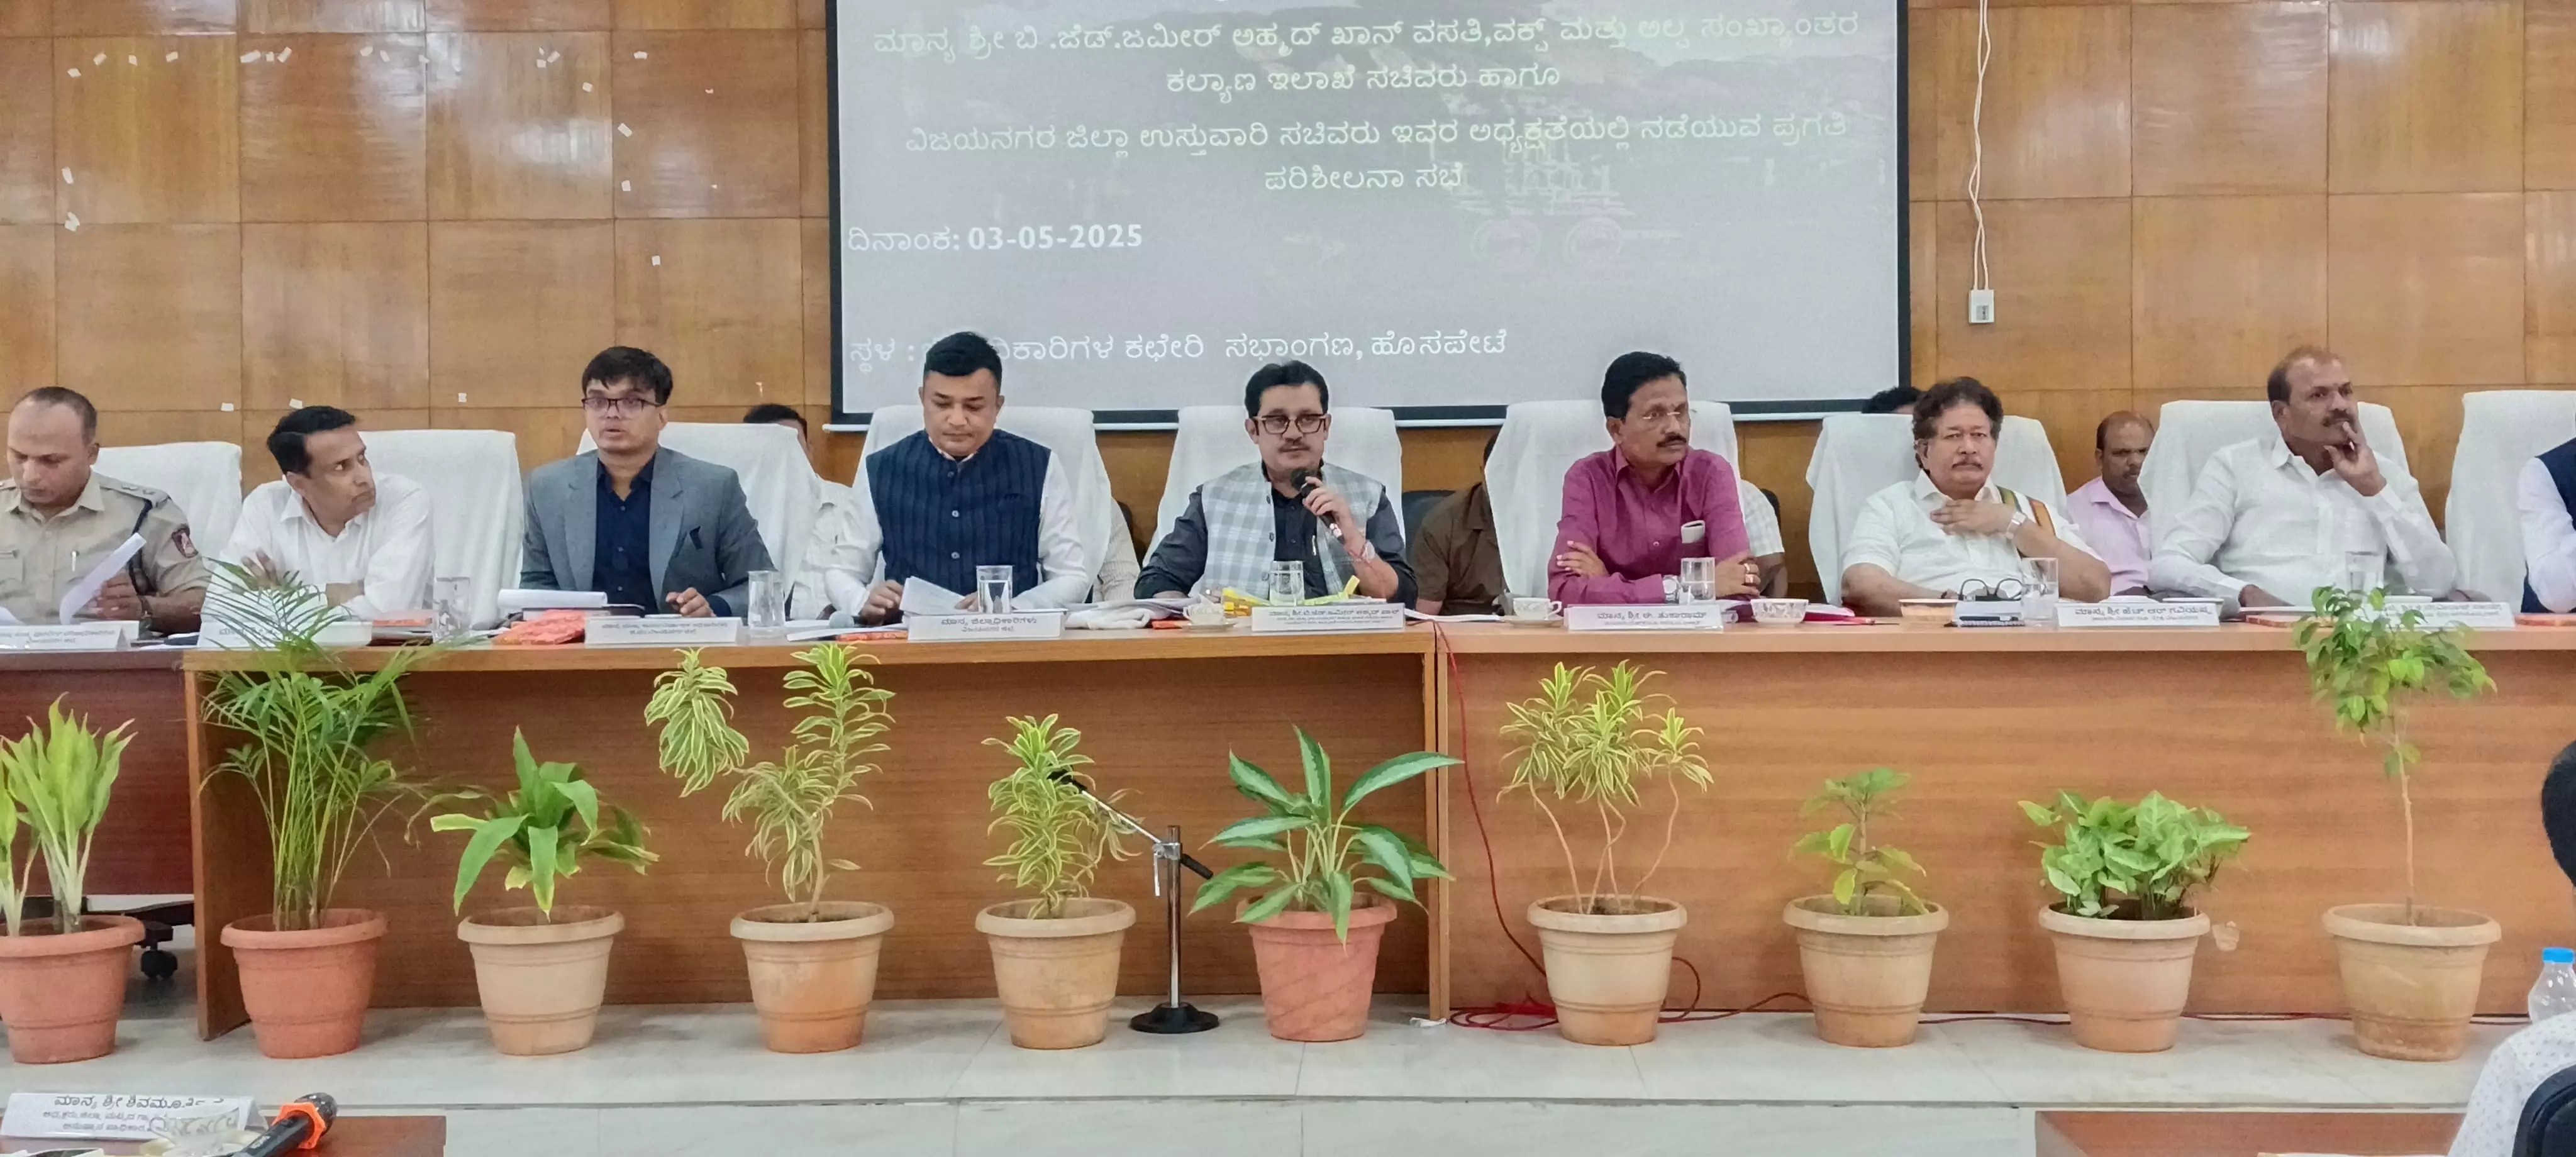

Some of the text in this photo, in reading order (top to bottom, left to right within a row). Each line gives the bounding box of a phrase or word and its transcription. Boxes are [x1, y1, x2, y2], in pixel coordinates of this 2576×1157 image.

[874, 28, 956, 64] ಮಾನ್ಯ
[969, 23, 1004, 60] ಶ್ರೀ
[1016, 24, 1038, 49] ಬಿ
[1331, 20, 1403, 45] ಖಾನ್
[1560, 15, 1627, 49] ಮತ್ತು
[1638, 19, 1690, 50] ಅಲ್ಪ
[1167, 63, 1560, 104] ಕಲ್ಯಾಣ ಇಲಾಖೆ ಸಚಿವರು ಹಾಗೂ
[906, 112, 1845, 158] ವಿಜಯನಗರ ಜಿಲ್ಲಾ ಉಸ್ತುವಾರಿ ಸಚಿವರು ಇವರ ಅಧ್ಯಕ್ಷತೆಯಲ್ಲಿ ನಡೆಯುವ ಪ್ರಗತಿ
[1265, 162, 1463, 191] ಪರಿಶೀಲನಾ ಸಭೆ
[848, 224, 1143, 252] ದಿನಾಂಕ: 03-05-2025
[850, 337, 896, 375] ಸ್ಥಳ
[1125, 334, 1204, 362] ಕಛೇರಿ
[1371, 329, 1507, 355] ಹೊಸಪೇಟೆ
[55, 1096, 96, 1109] ಮಾನ್ಯ
[103, 1095, 123, 1110] ಶ್ರೀ
